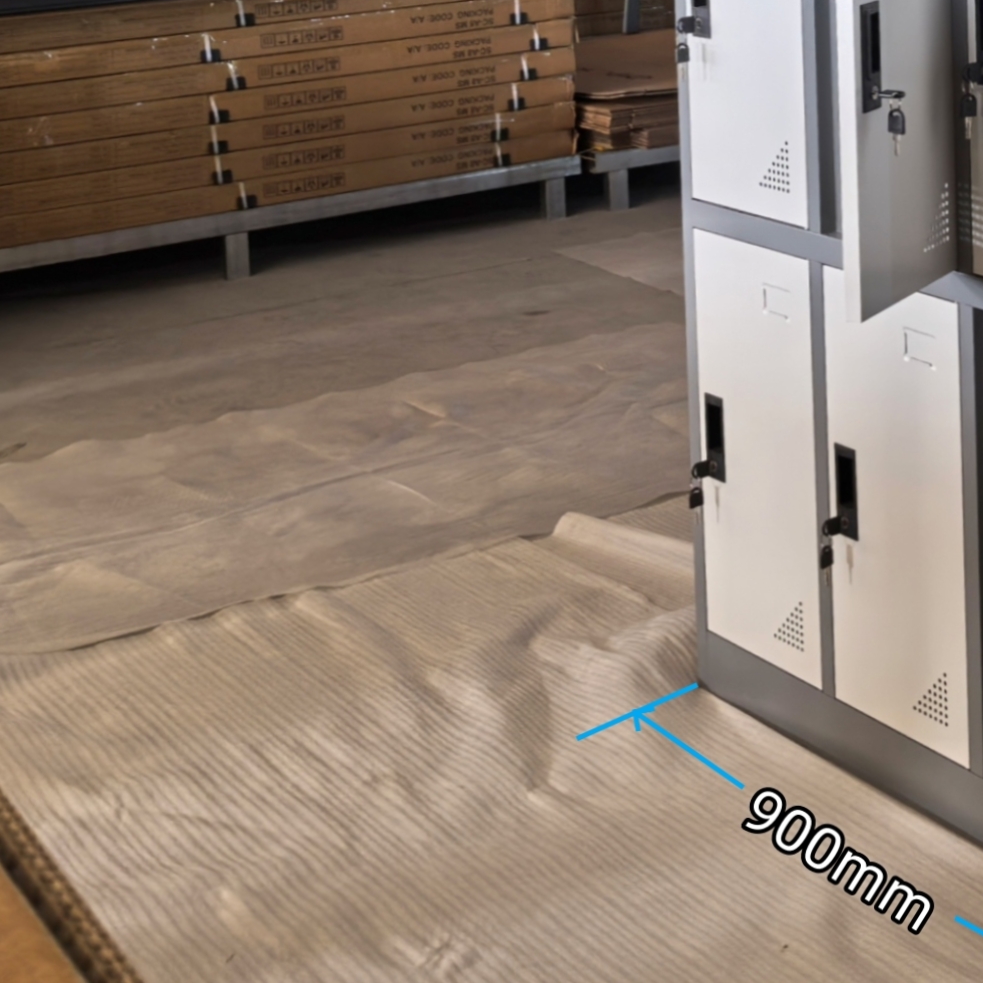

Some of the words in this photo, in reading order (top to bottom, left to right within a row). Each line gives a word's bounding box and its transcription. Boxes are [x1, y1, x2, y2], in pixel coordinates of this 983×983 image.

[458, 9, 493, 18] PACKING
[455, 38, 491, 48] PACKING
[459, 67, 495, 76] PACKING
